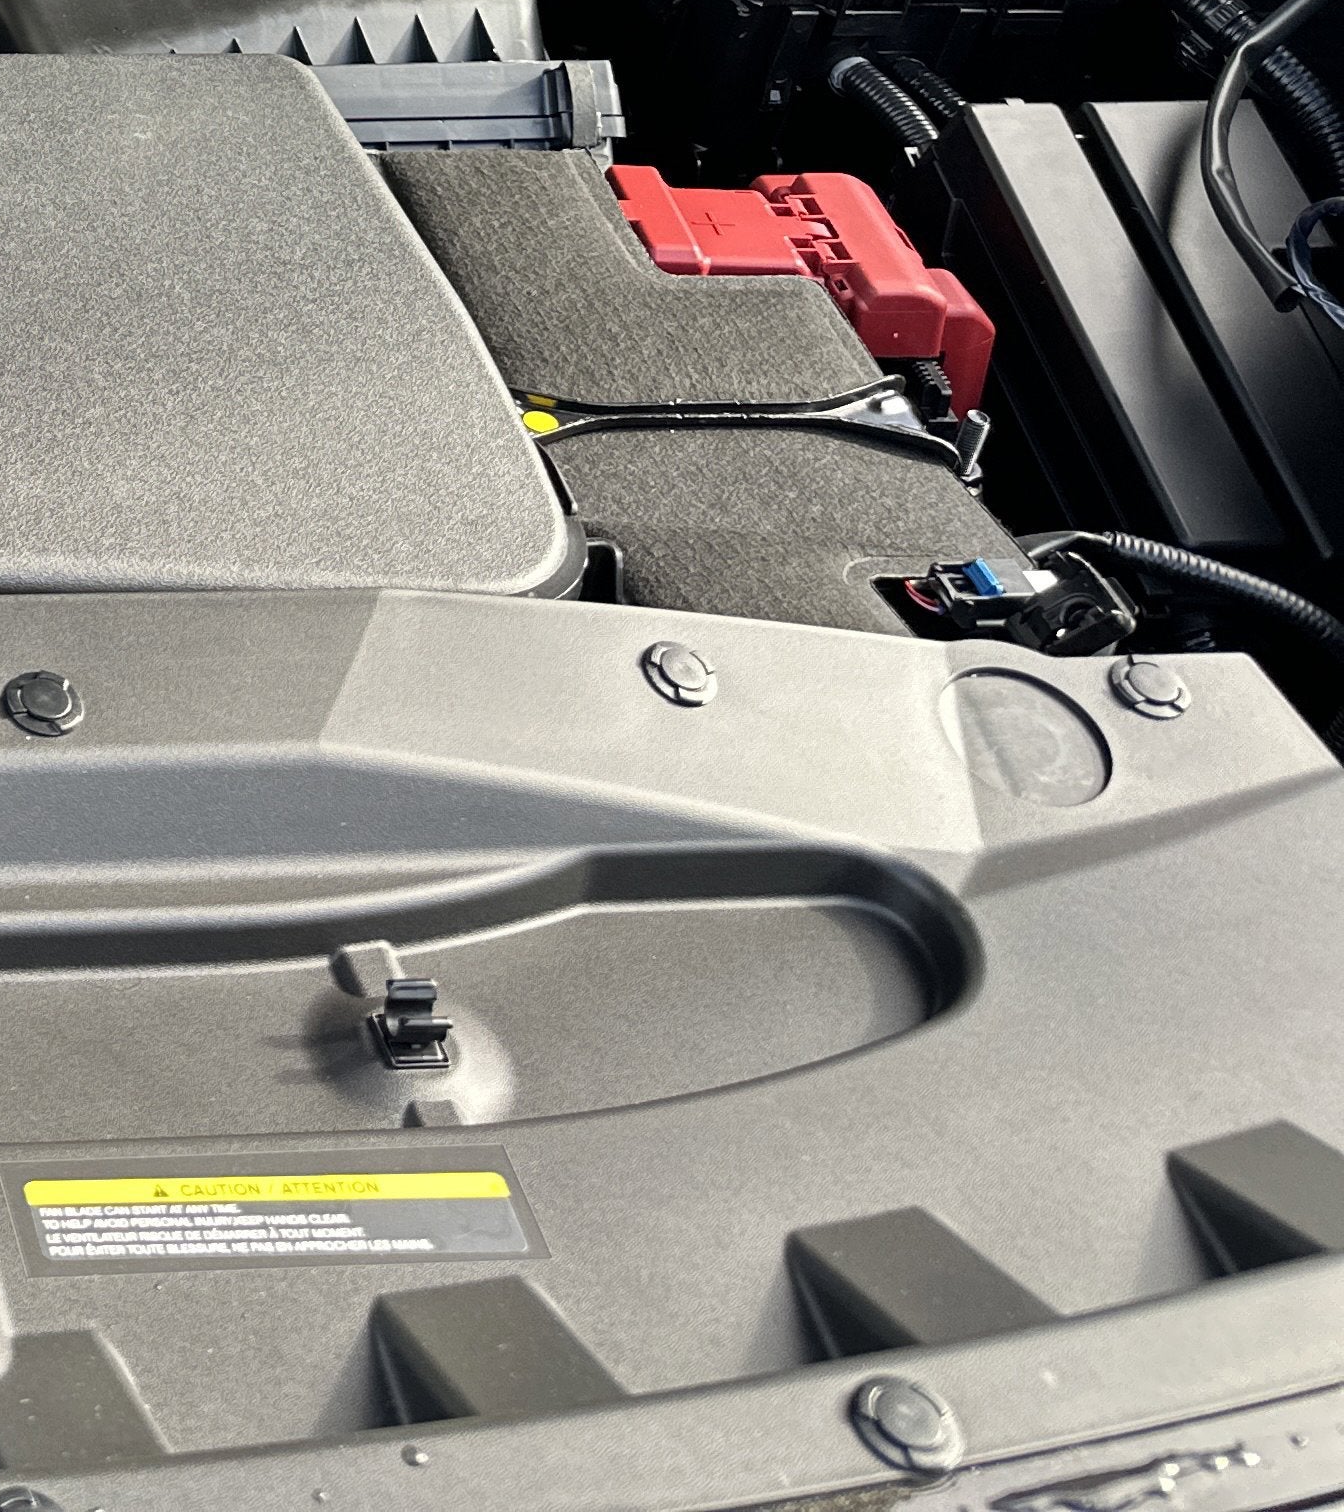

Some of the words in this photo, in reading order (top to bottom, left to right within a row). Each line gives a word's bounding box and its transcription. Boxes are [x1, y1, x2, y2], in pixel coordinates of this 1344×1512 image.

[180, 1184, 261, 1197] CAUTION
[282, 1181, 380, 1195] ATTENTION
[39, 1207, 62, 1217] FAN
[64, 1206, 103, 1217] BLADE
[104, 1205, 130, 1216] CAN
[131, 1205, 167, 1215] START
[169, 1205, 183, 1214] AT
[185, 1204, 209, 1214] ANY
[42, 1219, 60, 1229] TO
[61, 1218, 92, 1229] HELP
[93, 1217, 129, 1229] AVOID
[130, 1216, 194, 1228] PERSONAL
[264, 1214, 308, 1225] HANDS
[45, 1233, 62, 1244] LE
[63, 1231, 138, 1243] VENTILATEUR
[138, 1231, 184, 1242] RISQUE
[184, 1230, 202, 1241] DE
[202, 1228, 268, 1240] DÉMARRER
[269, 1226, 279, 1238] À
[279, 1228, 309, 1238] TOUT
[311, 1226, 366, 1238] MOMENT.
[48, 1244, 84, 1256] POUR
[127, 1243, 166, 1255] TOUTE
[231, 1242, 249, 1253] NE
[250, 1241, 274, 1252] PAS
[275, 1241, 294, 1252] EN
[294, 1239, 368, 1252] APPROCHER
[368, 1239, 391, 1251] LES
